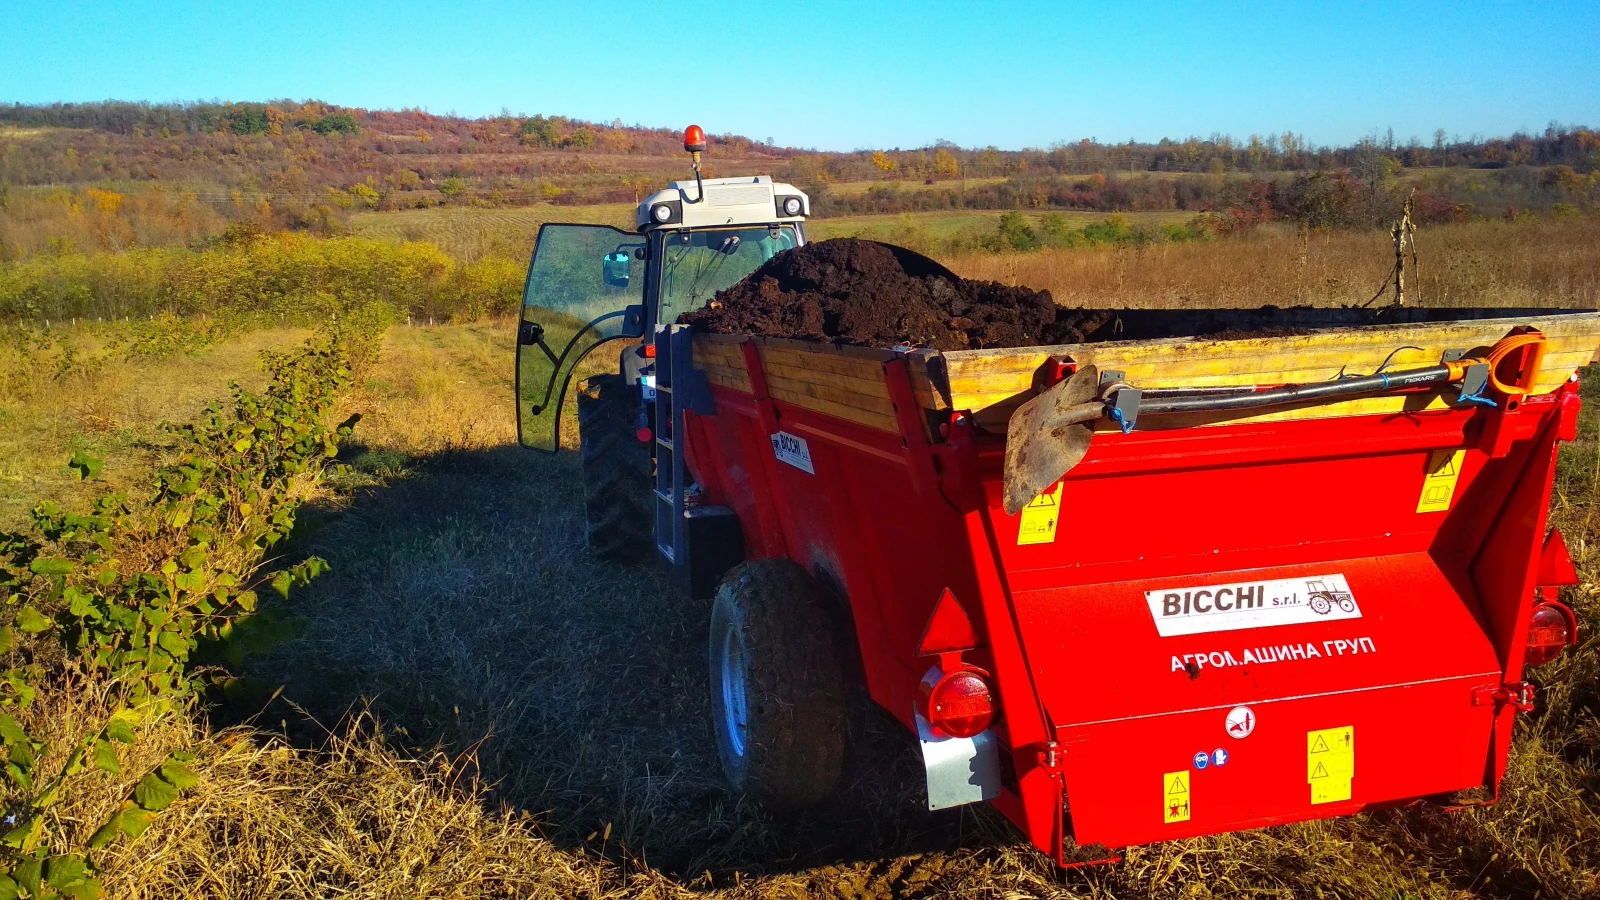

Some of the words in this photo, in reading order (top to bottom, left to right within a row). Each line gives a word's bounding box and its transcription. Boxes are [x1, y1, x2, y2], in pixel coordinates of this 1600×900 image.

[780, 433, 801, 456] BICCHI
[1163, 585, 1265, 616] BICCHI
[1272, 593, 1301, 606] s.r.l.
[1323, 637, 1376, 656] ГРУП
